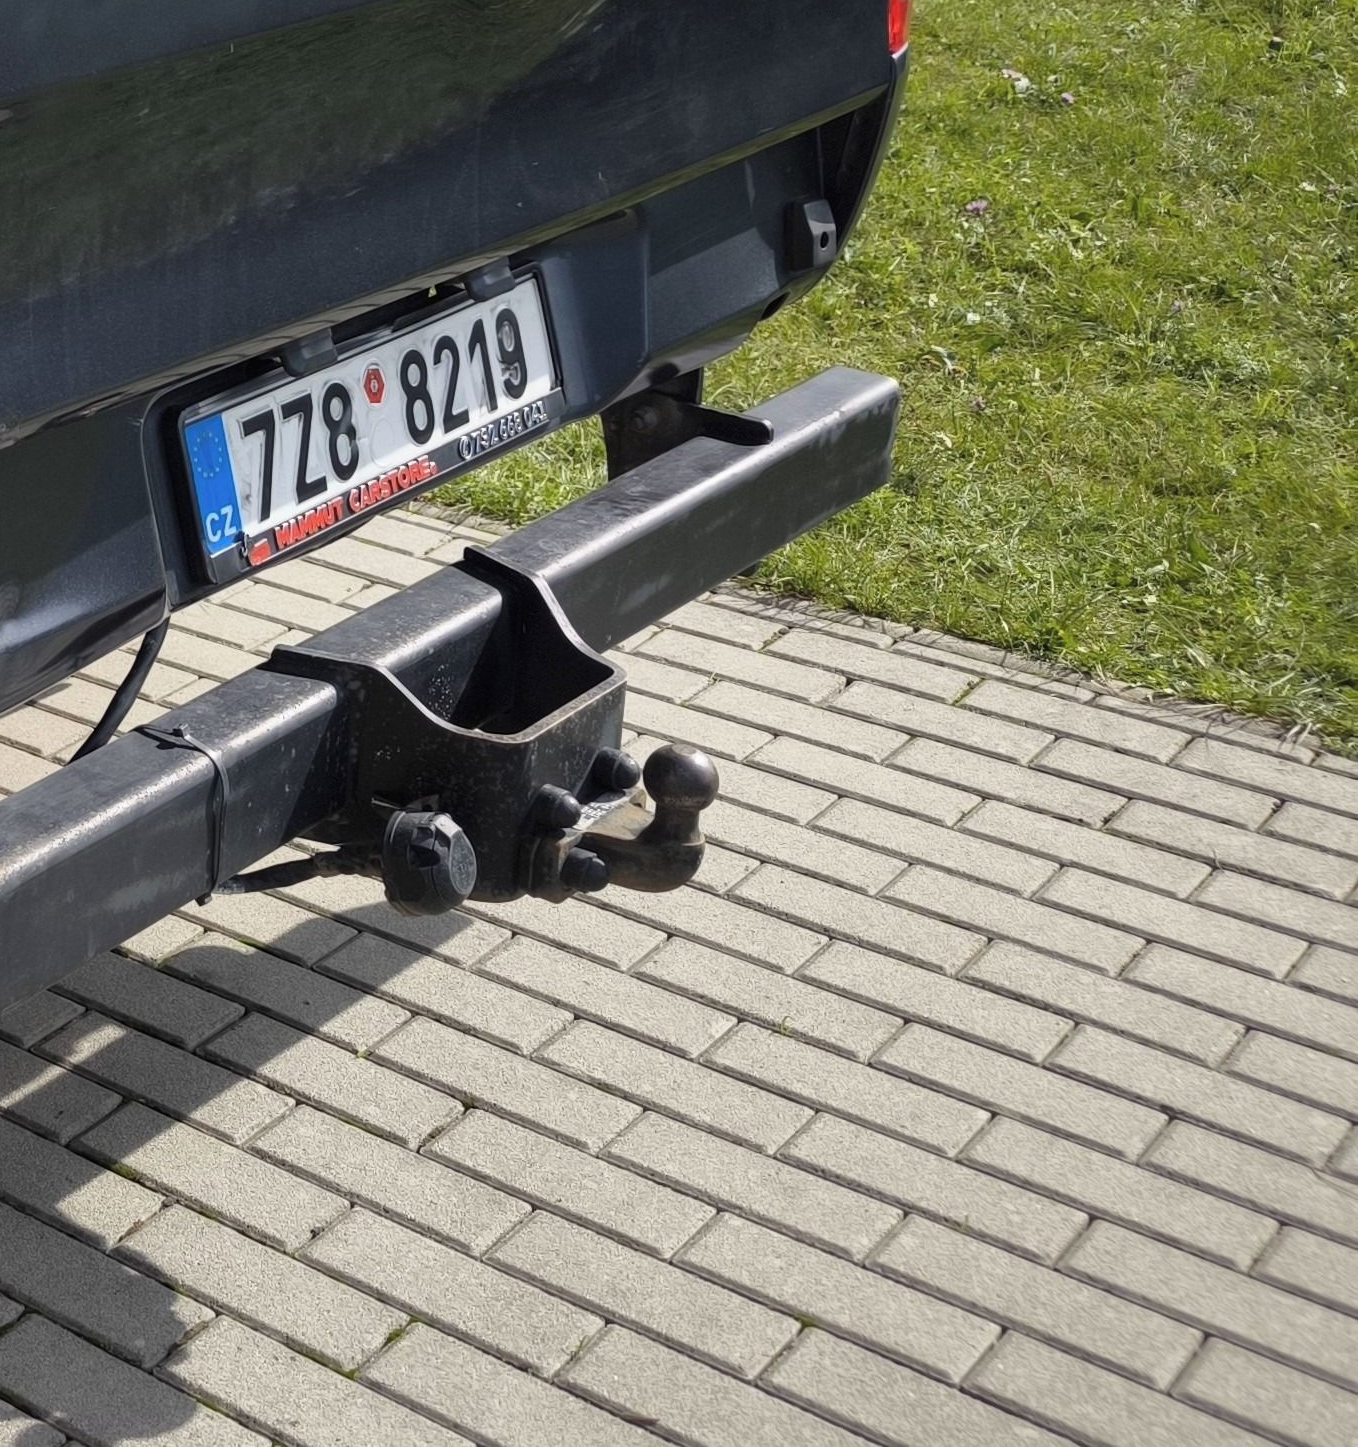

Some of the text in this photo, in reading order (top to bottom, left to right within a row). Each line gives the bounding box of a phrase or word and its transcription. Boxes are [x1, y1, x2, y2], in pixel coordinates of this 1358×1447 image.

[239, 307, 529, 524] 7Z8 8219
[206, 504, 237, 544] CZ
[275, 496, 344, 551] MAMMUT
